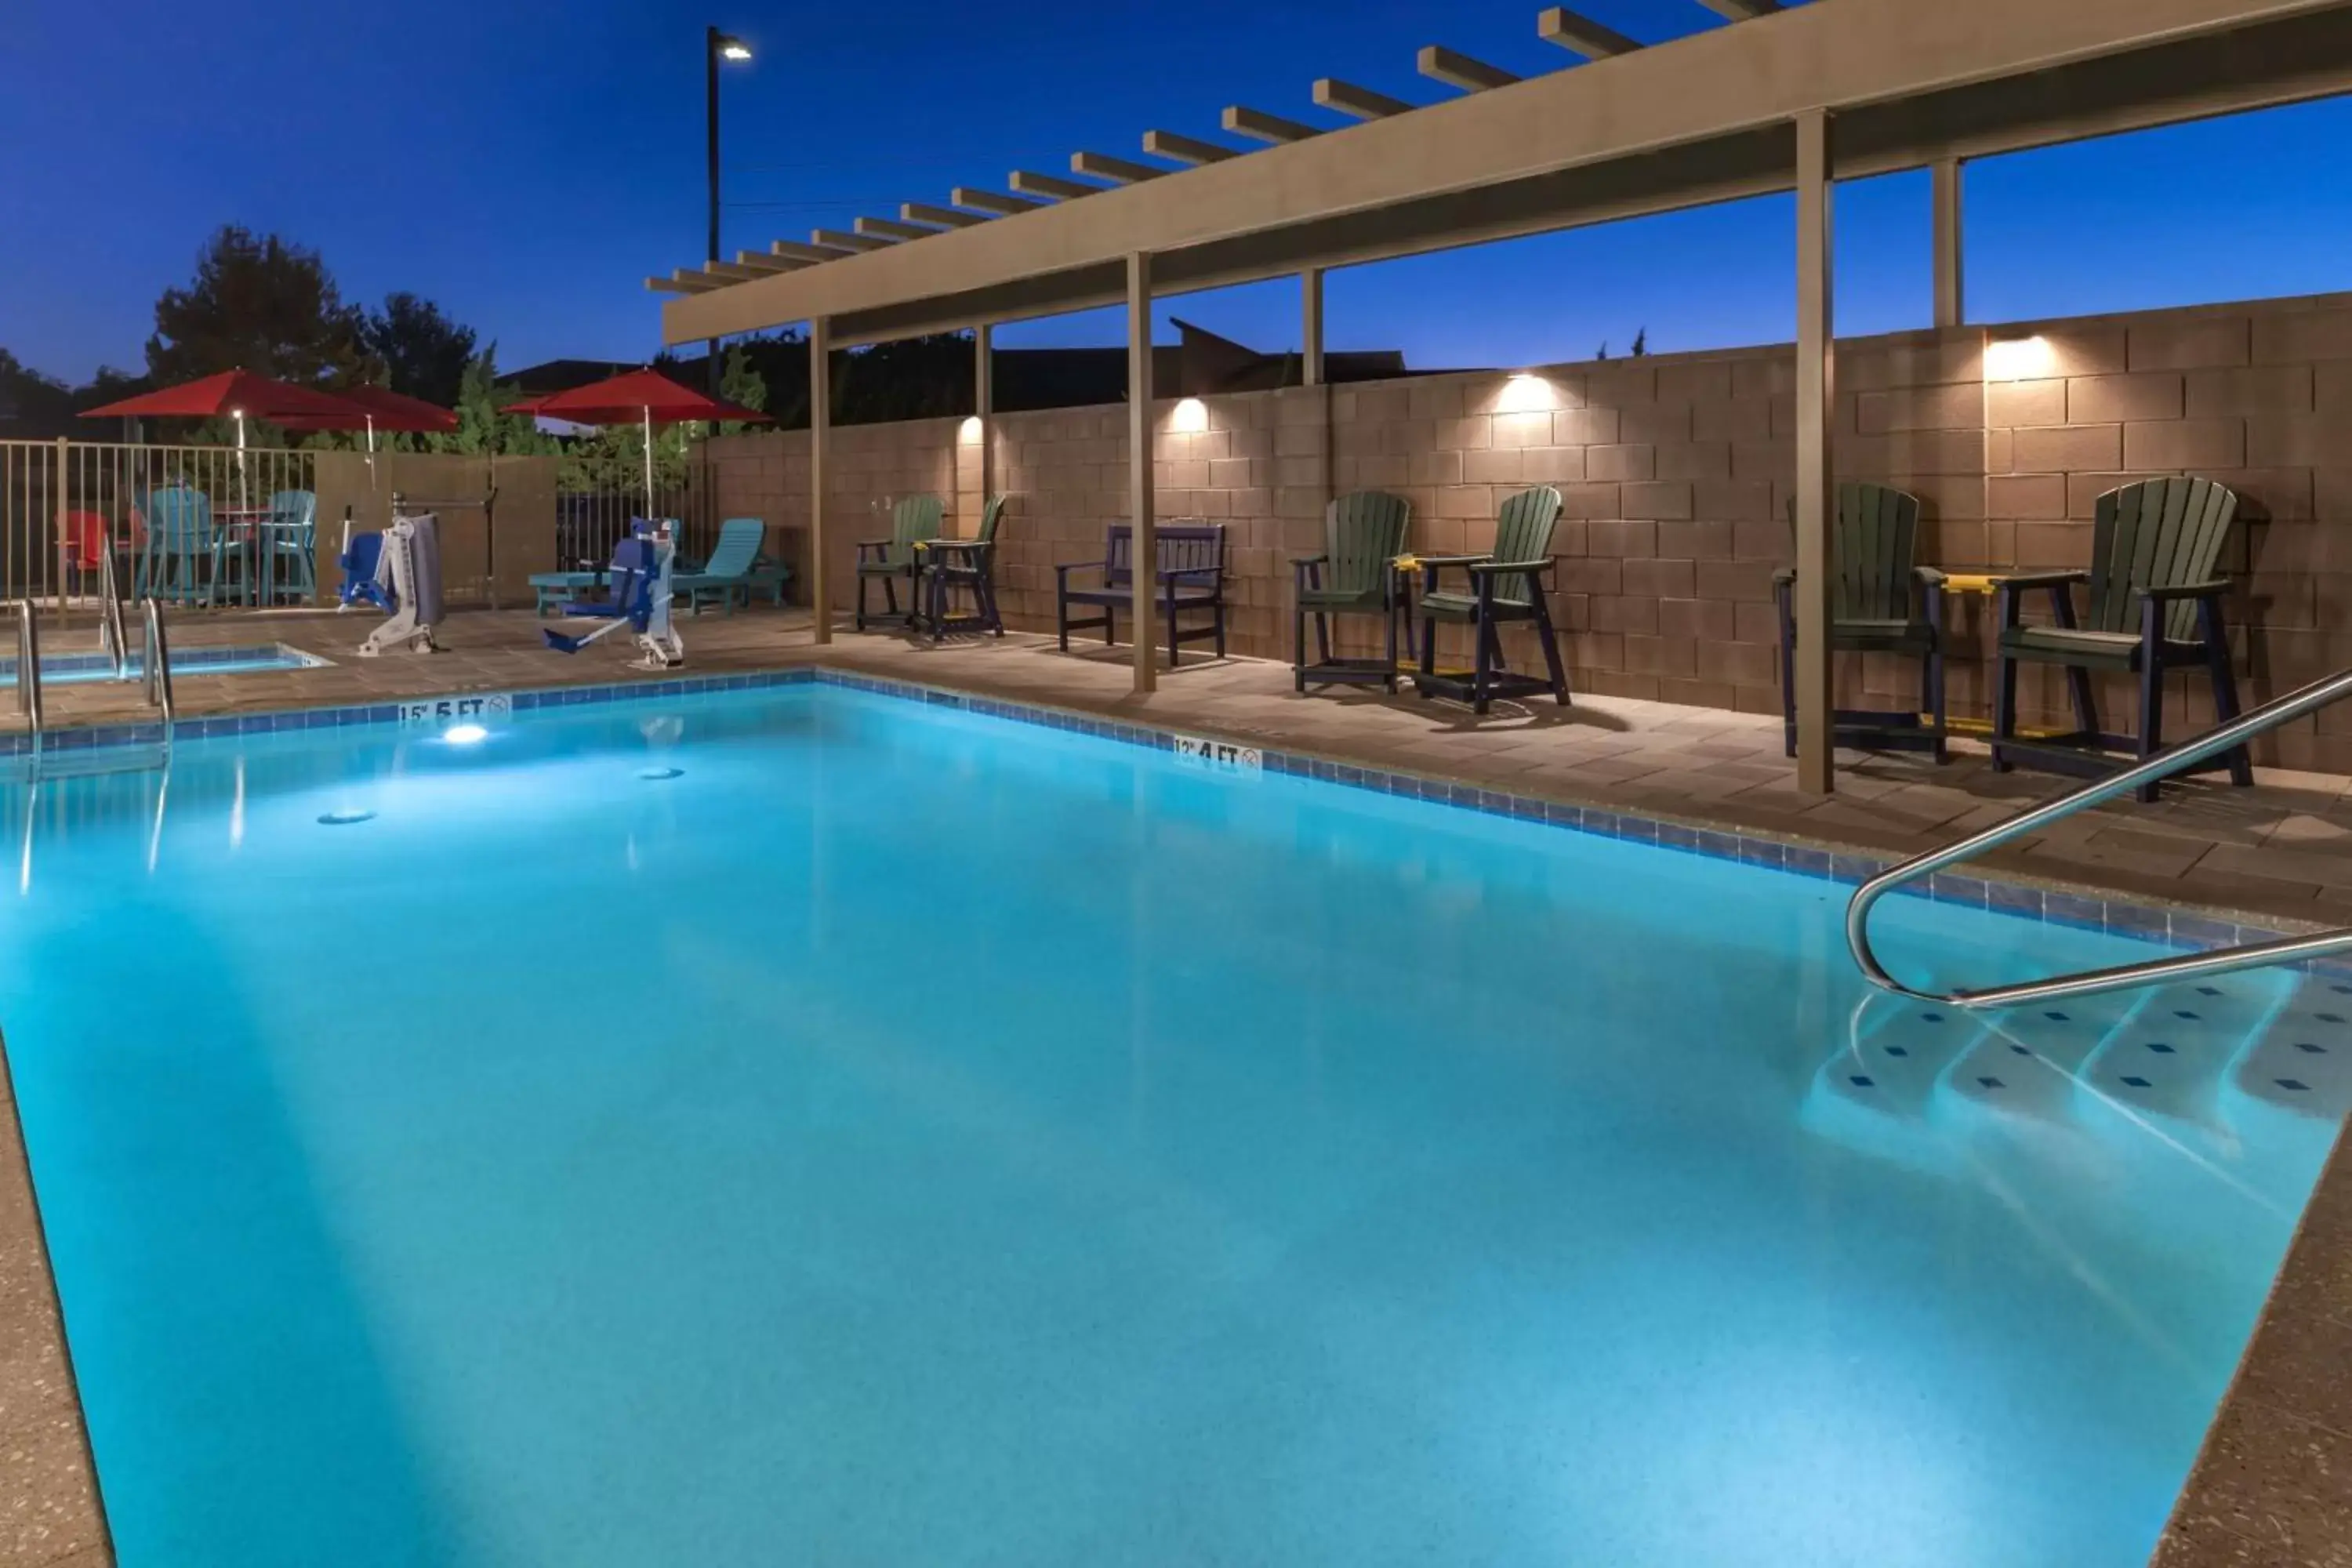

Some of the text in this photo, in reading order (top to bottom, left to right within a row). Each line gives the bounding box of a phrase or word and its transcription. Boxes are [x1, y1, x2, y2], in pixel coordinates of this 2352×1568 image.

[436, 702, 452, 716] 5
[458, 699, 484, 715] FT
[1199, 742, 1211, 759] 4
[1218, 744, 1238, 764] FT
